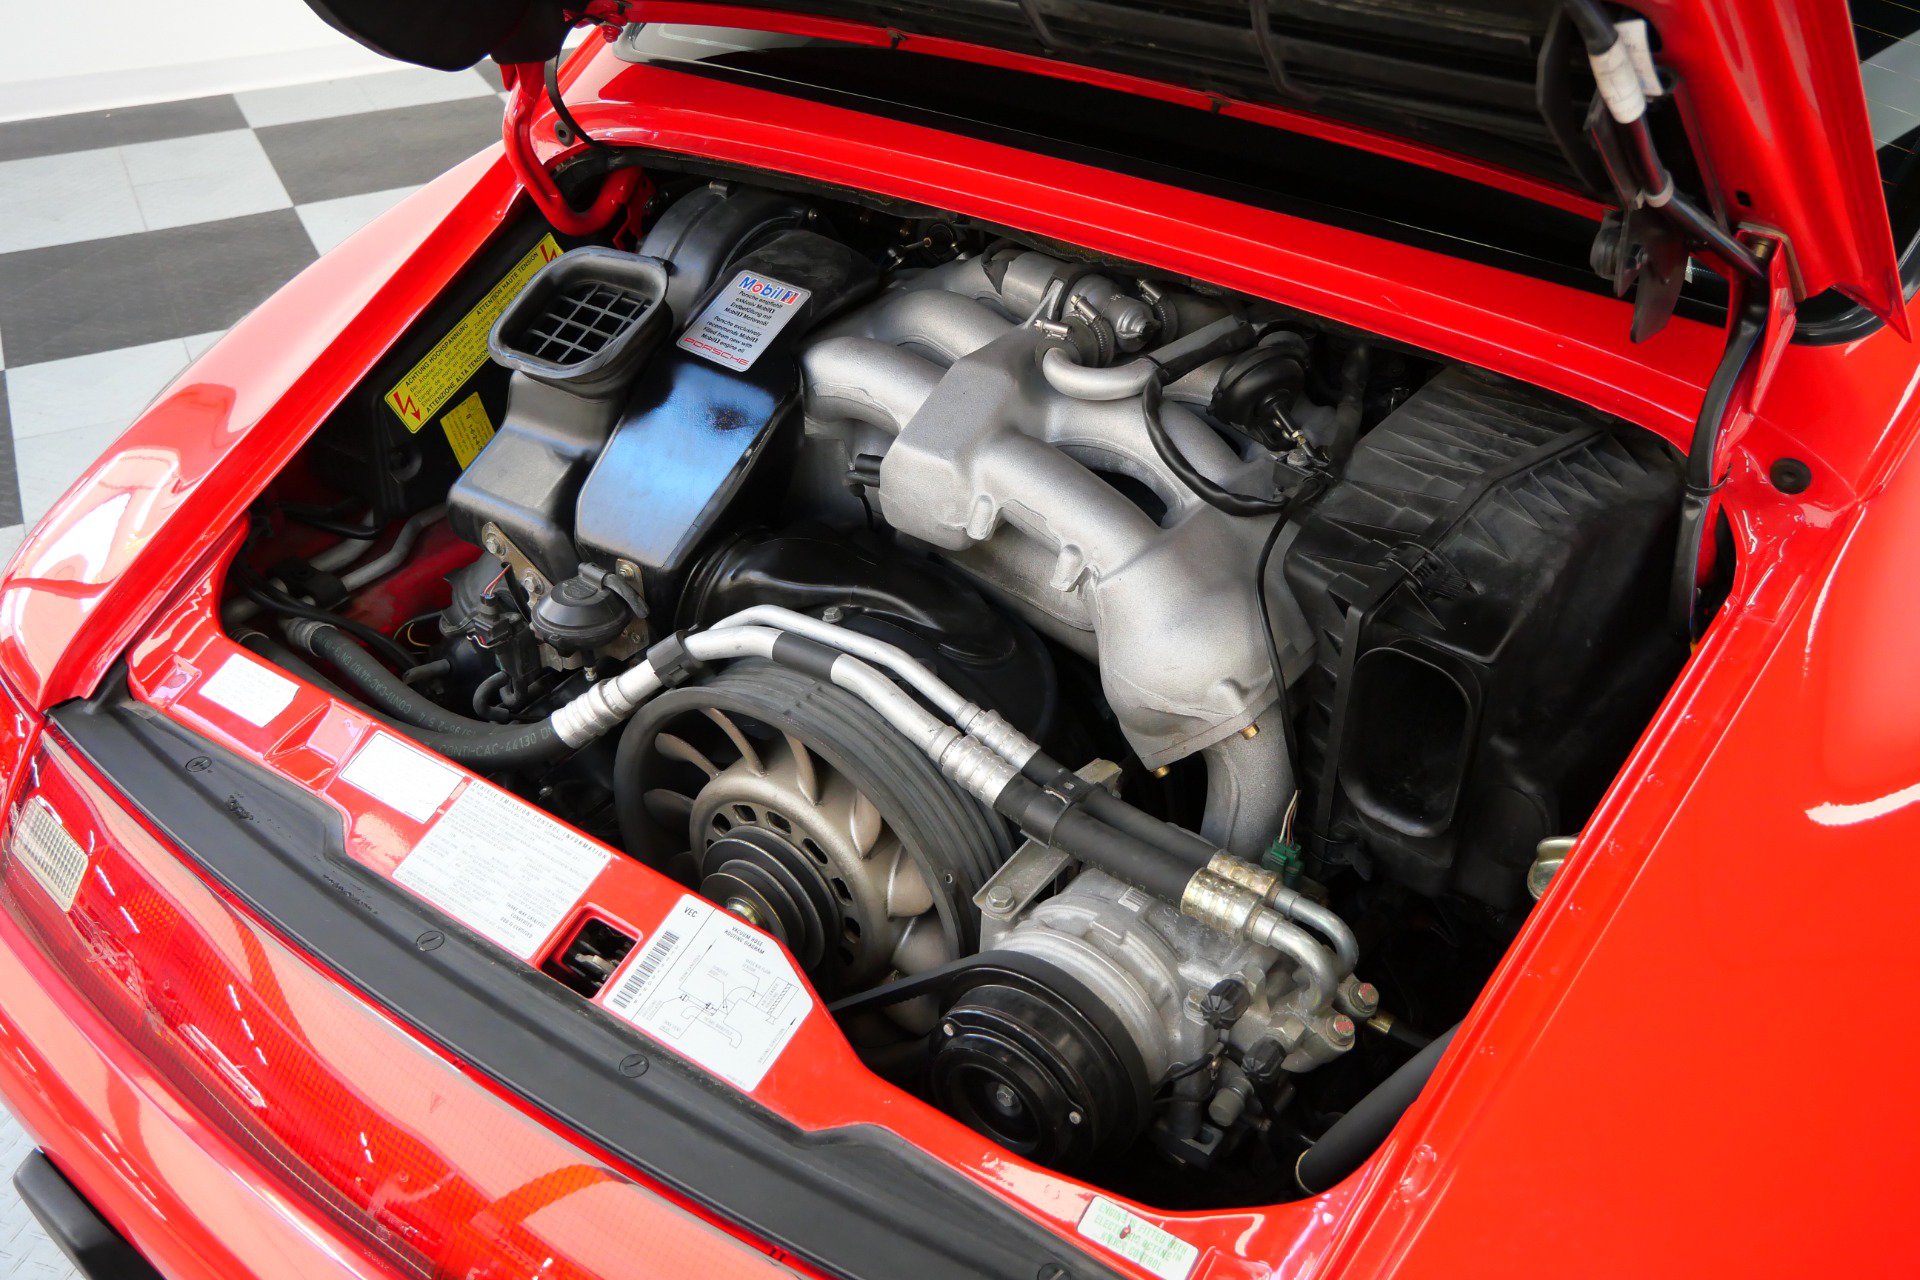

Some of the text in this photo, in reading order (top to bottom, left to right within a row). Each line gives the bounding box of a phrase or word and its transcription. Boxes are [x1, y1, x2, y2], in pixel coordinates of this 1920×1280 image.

[738, 276, 784, 300] Mobil
[738, 290, 783, 308] Porsche empfiehlt
[734, 296, 756, 306] exklusiv
[403, 360, 430, 388] ACHTUNG
[427, 321, 469, 364] HOCHSPANNUNG
[475, 287, 503, 316] ATTENTION
[501, 271, 519, 290] HAUTE
[515, 250, 539, 275] TENSION
[712, 315, 763, 337] Porsche exclusively
[701, 326, 718, 334] Filled
[715, 331, 730, 339] from
[739, 340, 754, 348] with
[717, 340, 738, 350] engine
[682, 337, 750, 365] PORSCHE
[425, 380, 456, 414] ATTENZIONE
[454, 367, 469, 383] ALTA
[498, 796, 532, 817] EMISSION
[560, 831, 609, 860] INFORMATION
[684, 907, 698, 917] VEC
[722, 928, 766, 955] ROUTING DIAGRAM
[729, 925, 751, 941] VACUUM
